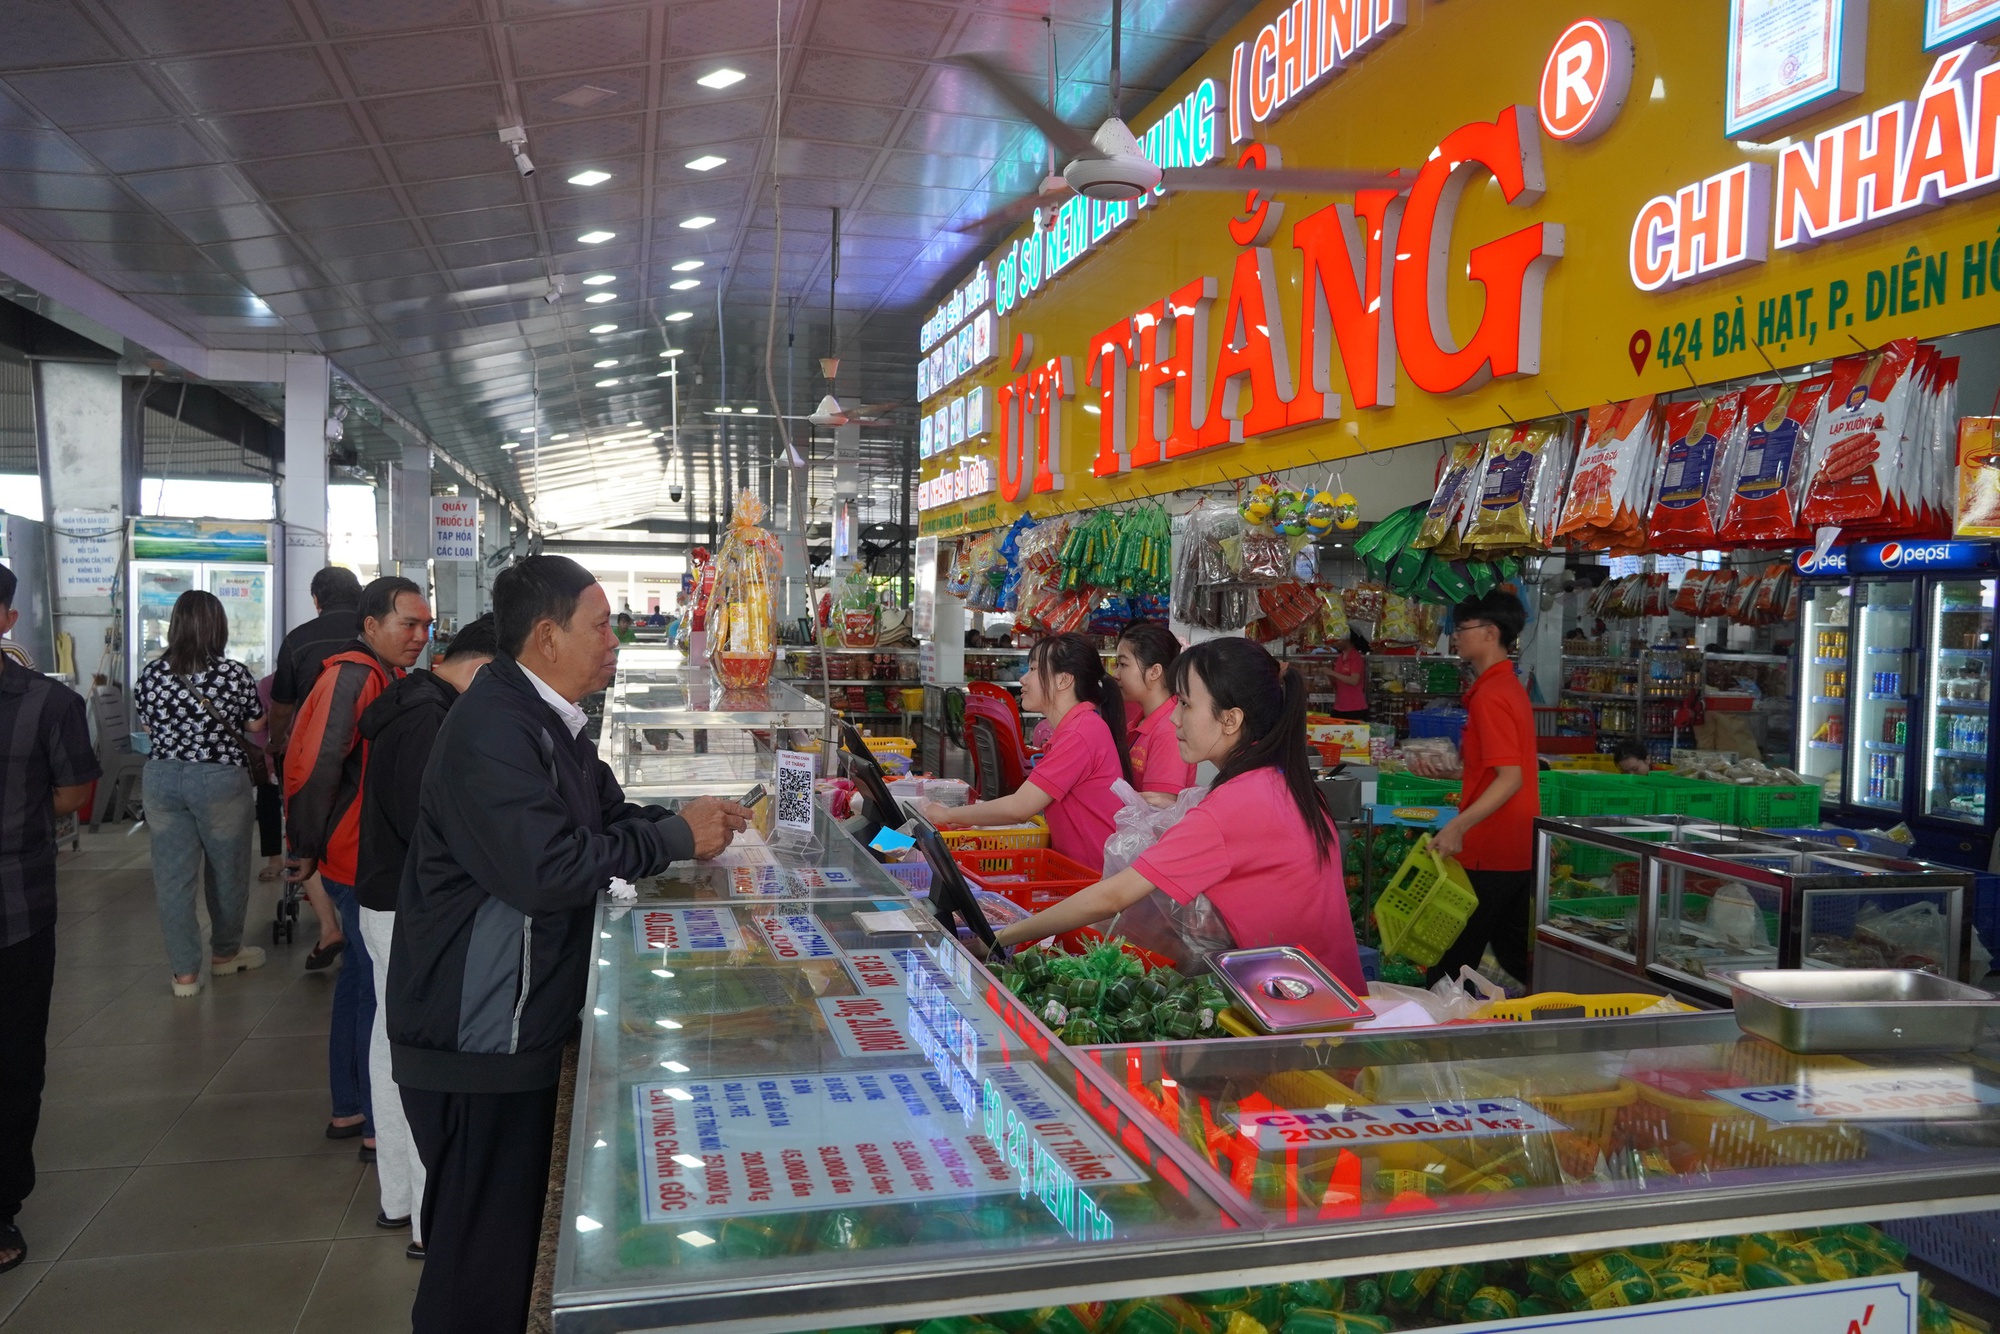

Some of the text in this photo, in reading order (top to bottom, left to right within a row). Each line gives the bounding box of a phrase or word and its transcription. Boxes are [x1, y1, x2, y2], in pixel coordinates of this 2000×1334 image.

[1630, 161, 1750, 291] CHI
[996, 240, 1018, 316] CƠ
[1019, 207, 1043, 298] SỞ
[1046, 193, 1088, 280] NEM
[998, 104, 1543, 502] ÚT THẲNG
[1656, 326, 1701, 368] 424
[1713, 293, 1746, 355] BÀ
[1757, 288, 1817, 354] HẠT,
[1827, 280, 1854, 331] P.
[1865, 245, 1948, 320] DIÊN
[435, 514, 474, 527] THUỐC LÁ
[438, 530, 472, 542] TẠP HÓA
[436, 545, 473, 558] CÁC LOẠI
[1903, 544, 1951, 566] pepsi
[798, 934, 834, 957] CHUA
[862, 973, 900, 987] 30K
[834, 999, 909, 1051] 100g 20.000đ
[1015, 1100, 1067, 1120] CHÂN
[1255, 1106, 1380, 1127] CHẢ
[650, 1107, 676, 1137] VUNG
[1032, 1121, 1083, 1137] ÚT
[1279, 1119, 1474, 1143] 200.000đ/
[816, 1145, 851, 1179] 50.000đ/
[854, 1142, 890, 1176] 60.000đ/
[1047, 1138, 1132, 1180] THẲNG
[866, 1175, 899, 1195] chục
[905, 1172, 939, 1191] chục
[658, 1180, 697, 1211] GỐC
[705, 1193, 732, 1205] kg
[746, 1189, 774, 1201] kg
